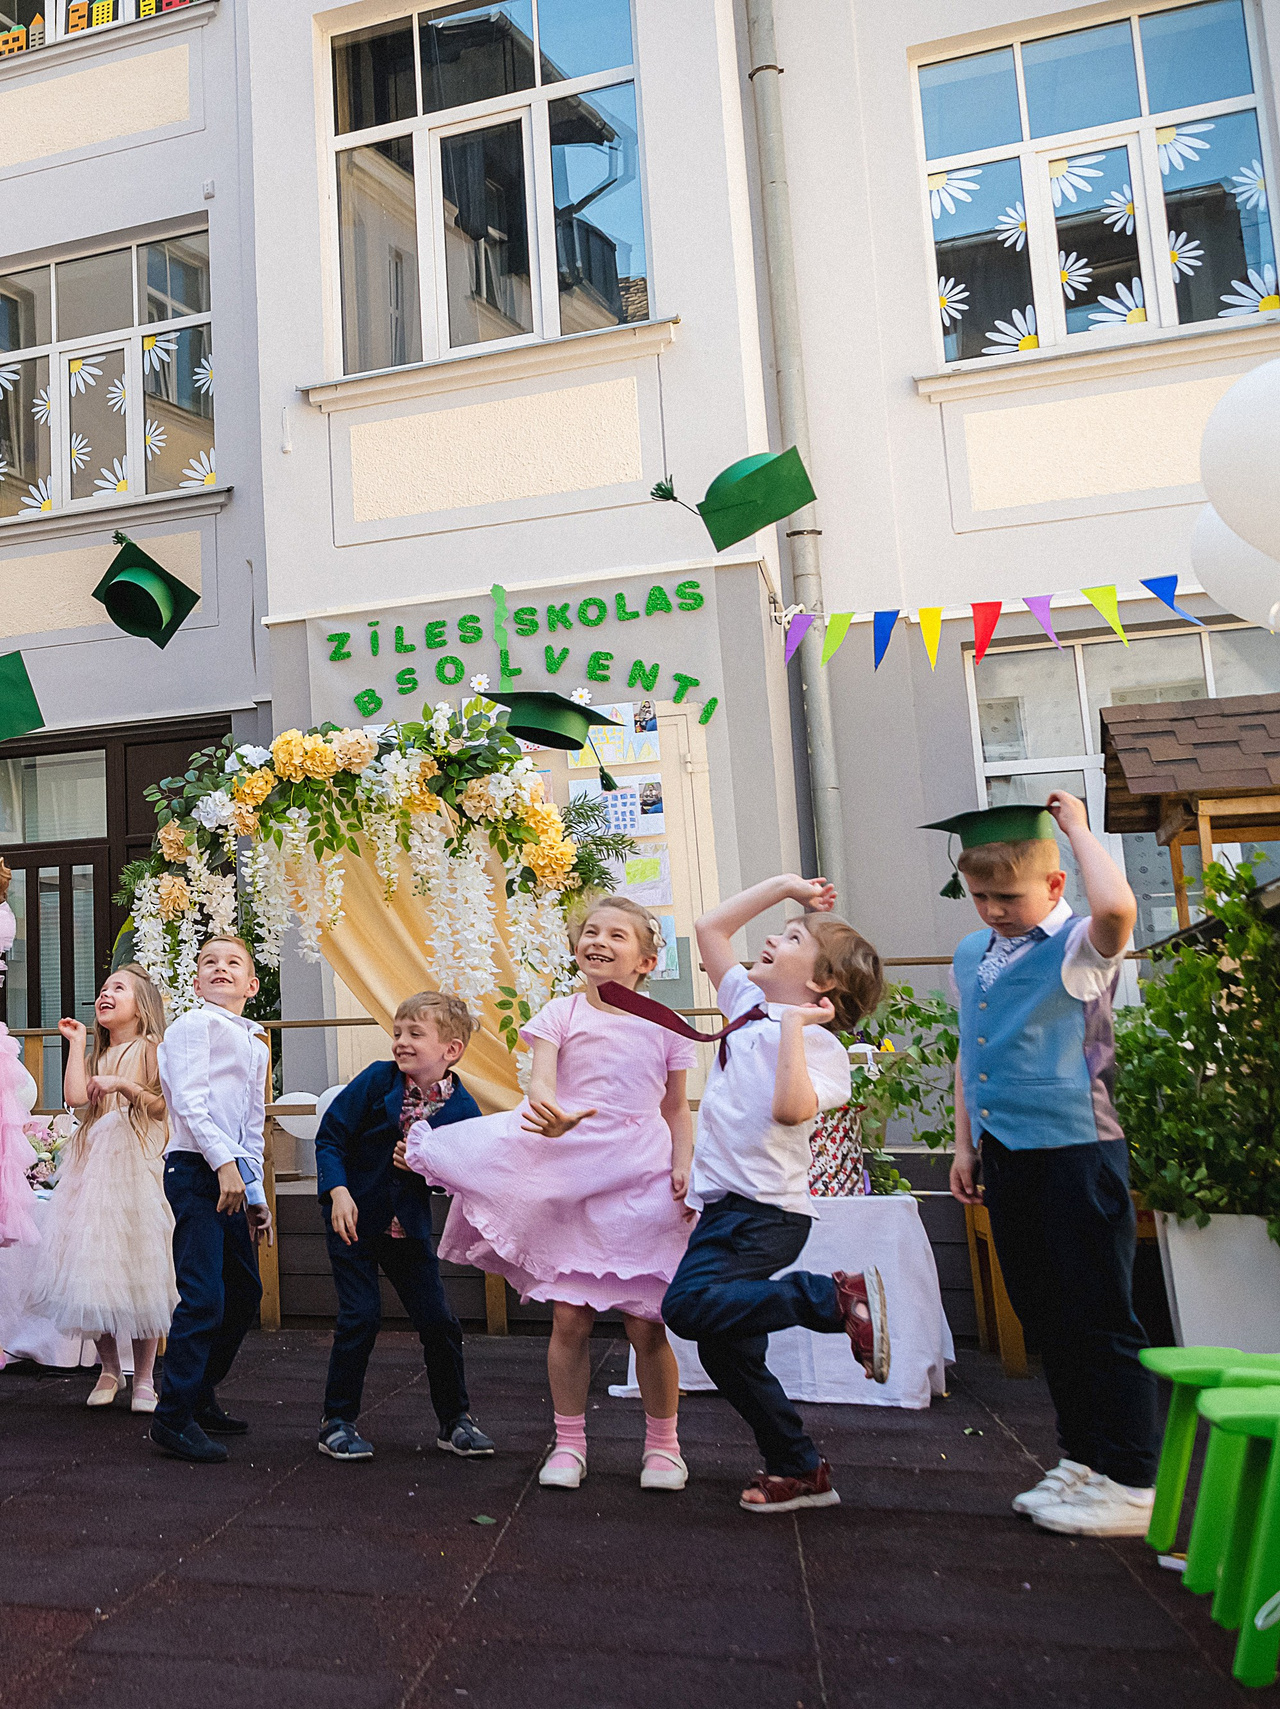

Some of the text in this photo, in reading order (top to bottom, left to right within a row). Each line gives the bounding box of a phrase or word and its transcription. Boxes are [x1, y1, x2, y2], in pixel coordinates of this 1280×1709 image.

[326, 580, 704, 661] ZĪLES SKOLAS
[330, 645, 718, 732] BSOLVENTI
